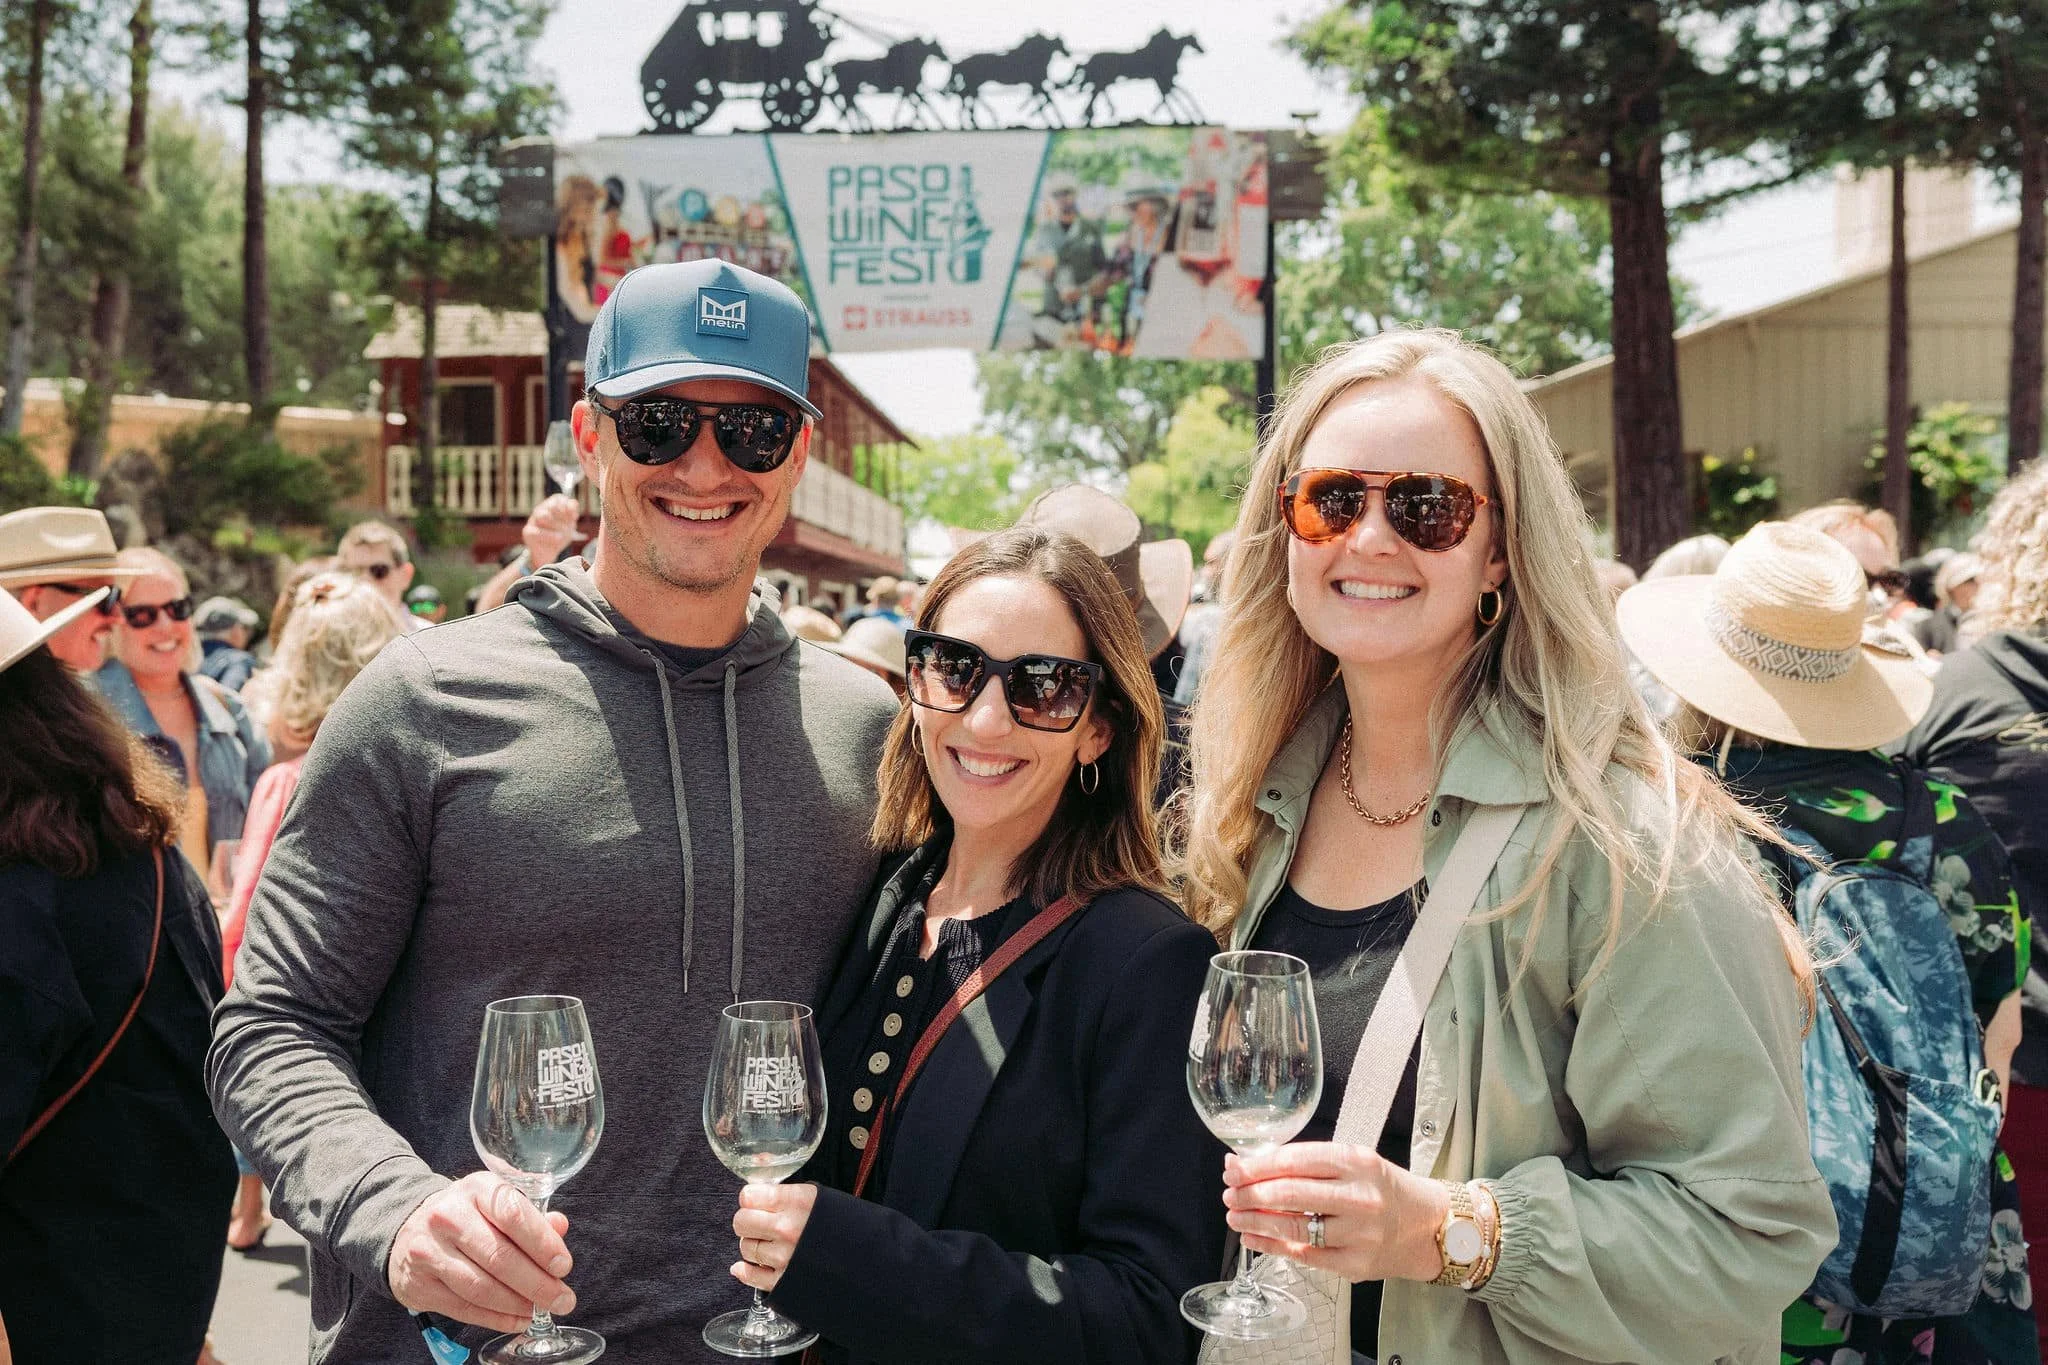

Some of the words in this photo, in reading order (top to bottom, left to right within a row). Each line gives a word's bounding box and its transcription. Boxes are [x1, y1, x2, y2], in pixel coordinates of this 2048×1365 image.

[828, 164, 950, 206] PASO
[828, 246, 944, 285] FEST
[701, 318, 746, 330] melin
[873, 308, 971, 327] STRAUSS
[538, 1043, 582, 1067] PASO
[745, 1057, 790, 1075] PASO
[742, 1090, 788, 1110] FEST
